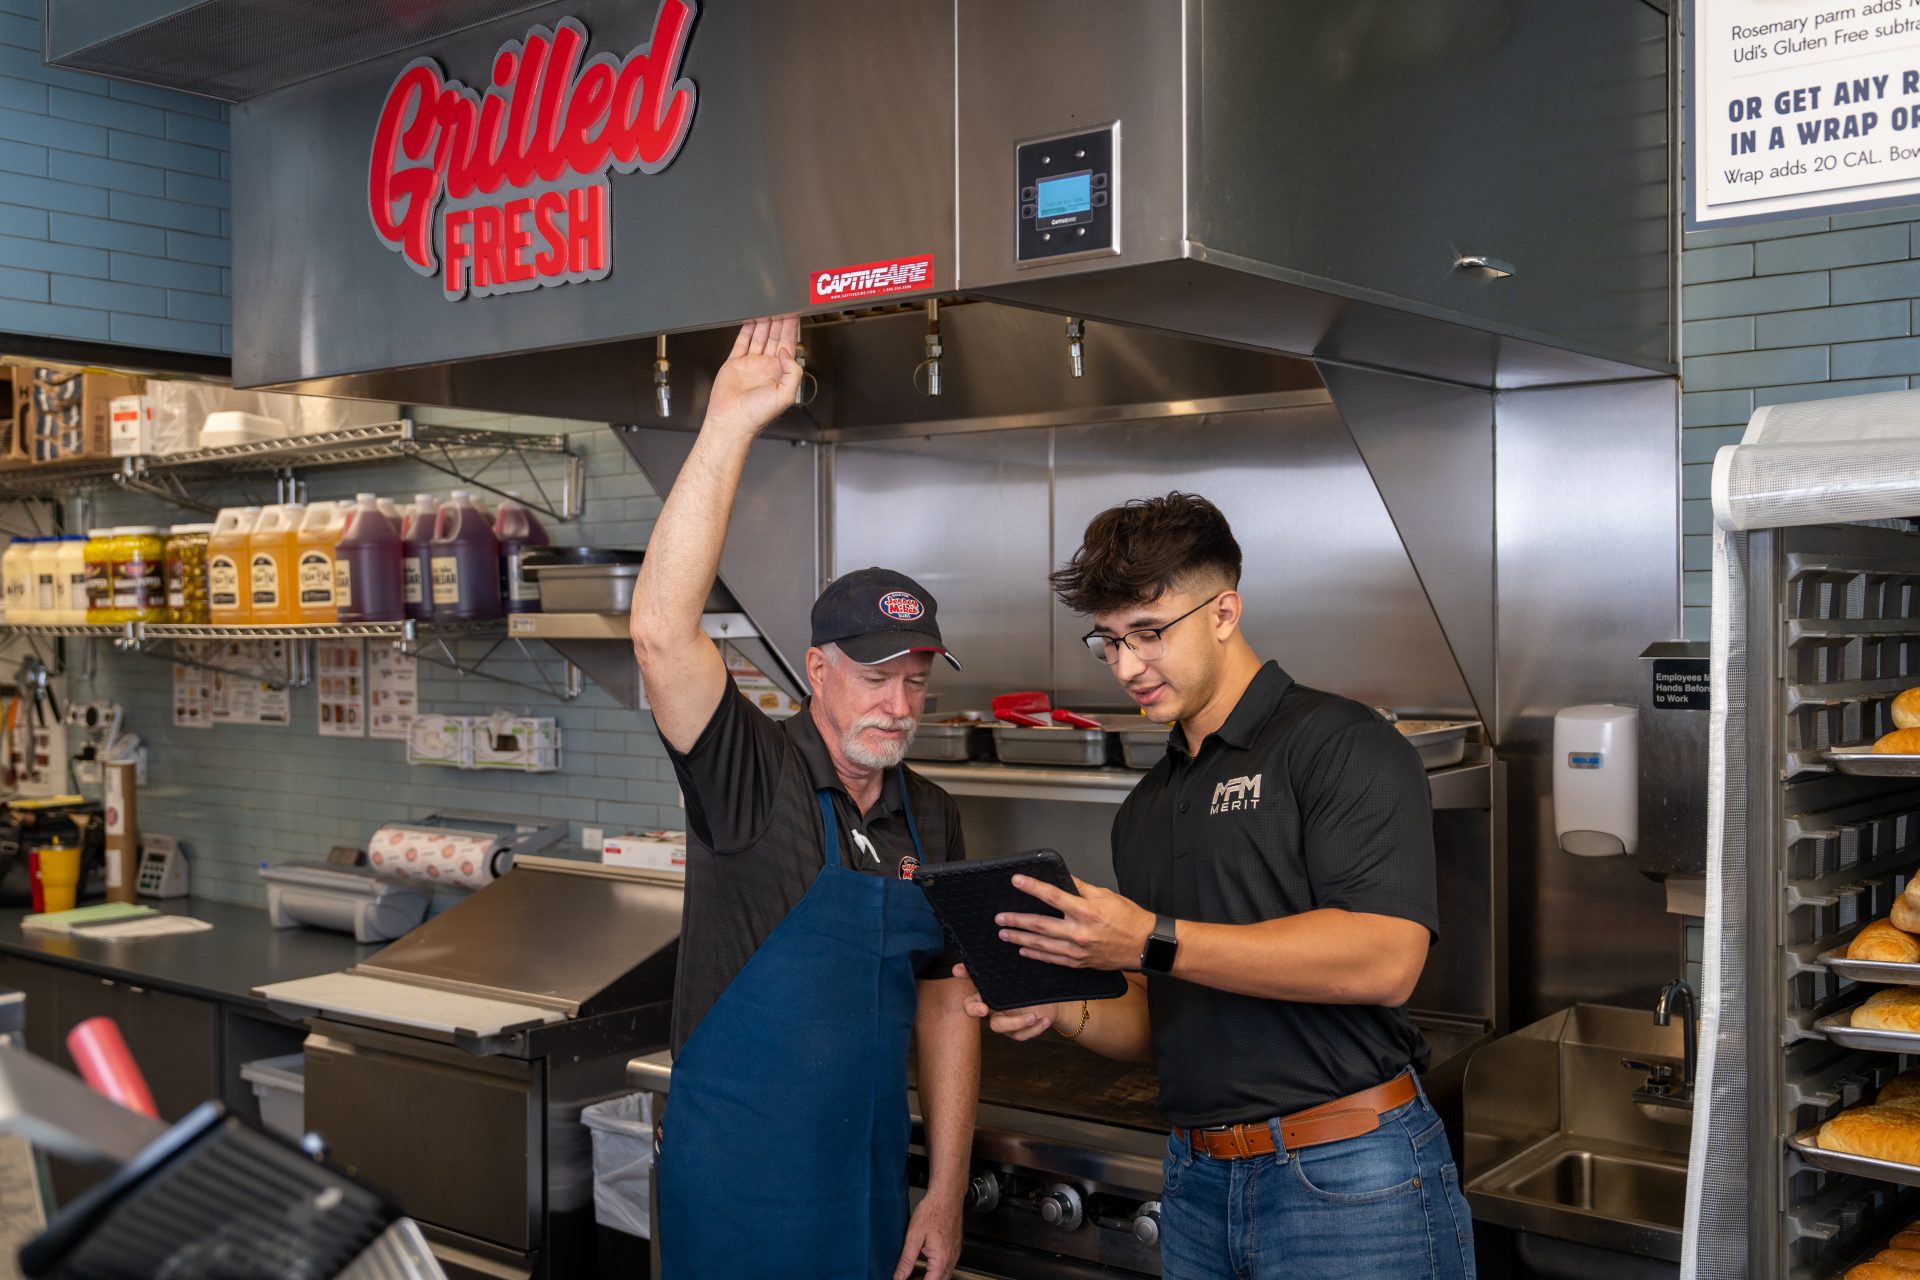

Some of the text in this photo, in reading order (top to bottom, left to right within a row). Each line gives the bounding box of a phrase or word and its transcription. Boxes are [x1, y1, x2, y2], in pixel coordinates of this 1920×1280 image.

[1731, 0, 1902, 41] Rosemary parm adds
[1733, 44, 1768, 63] Udi's
[1773, 37, 1828, 56] Gluten
[1834, 28, 1869, 46] Free
[1728, 96, 1762, 123] OR
[1773, 86, 1822, 116] GET
[1833, 74, 1889, 107] ANY
[370, 0, 689, 268] Grilled
[1730, 130, 1756, 156] IN
[1768, 126, 1785, 151] A
[1797, 111, 1878, 146] WRAP
[1724, 168, 1764, 185] Wrap
[1769, 159, 1807, 179] adds
[1814, 155, 1838, 172] 20
[1843, 150, 1883, 167] CAL.
[445, 184, 606, 292] FRESH
[1655, 672, 1702, 683] Employees
[1655, 683, 1683, 692] Hands
[1655, 694, 1689, 703] to Work
[1209, 799, 1260, 816] MERIT
